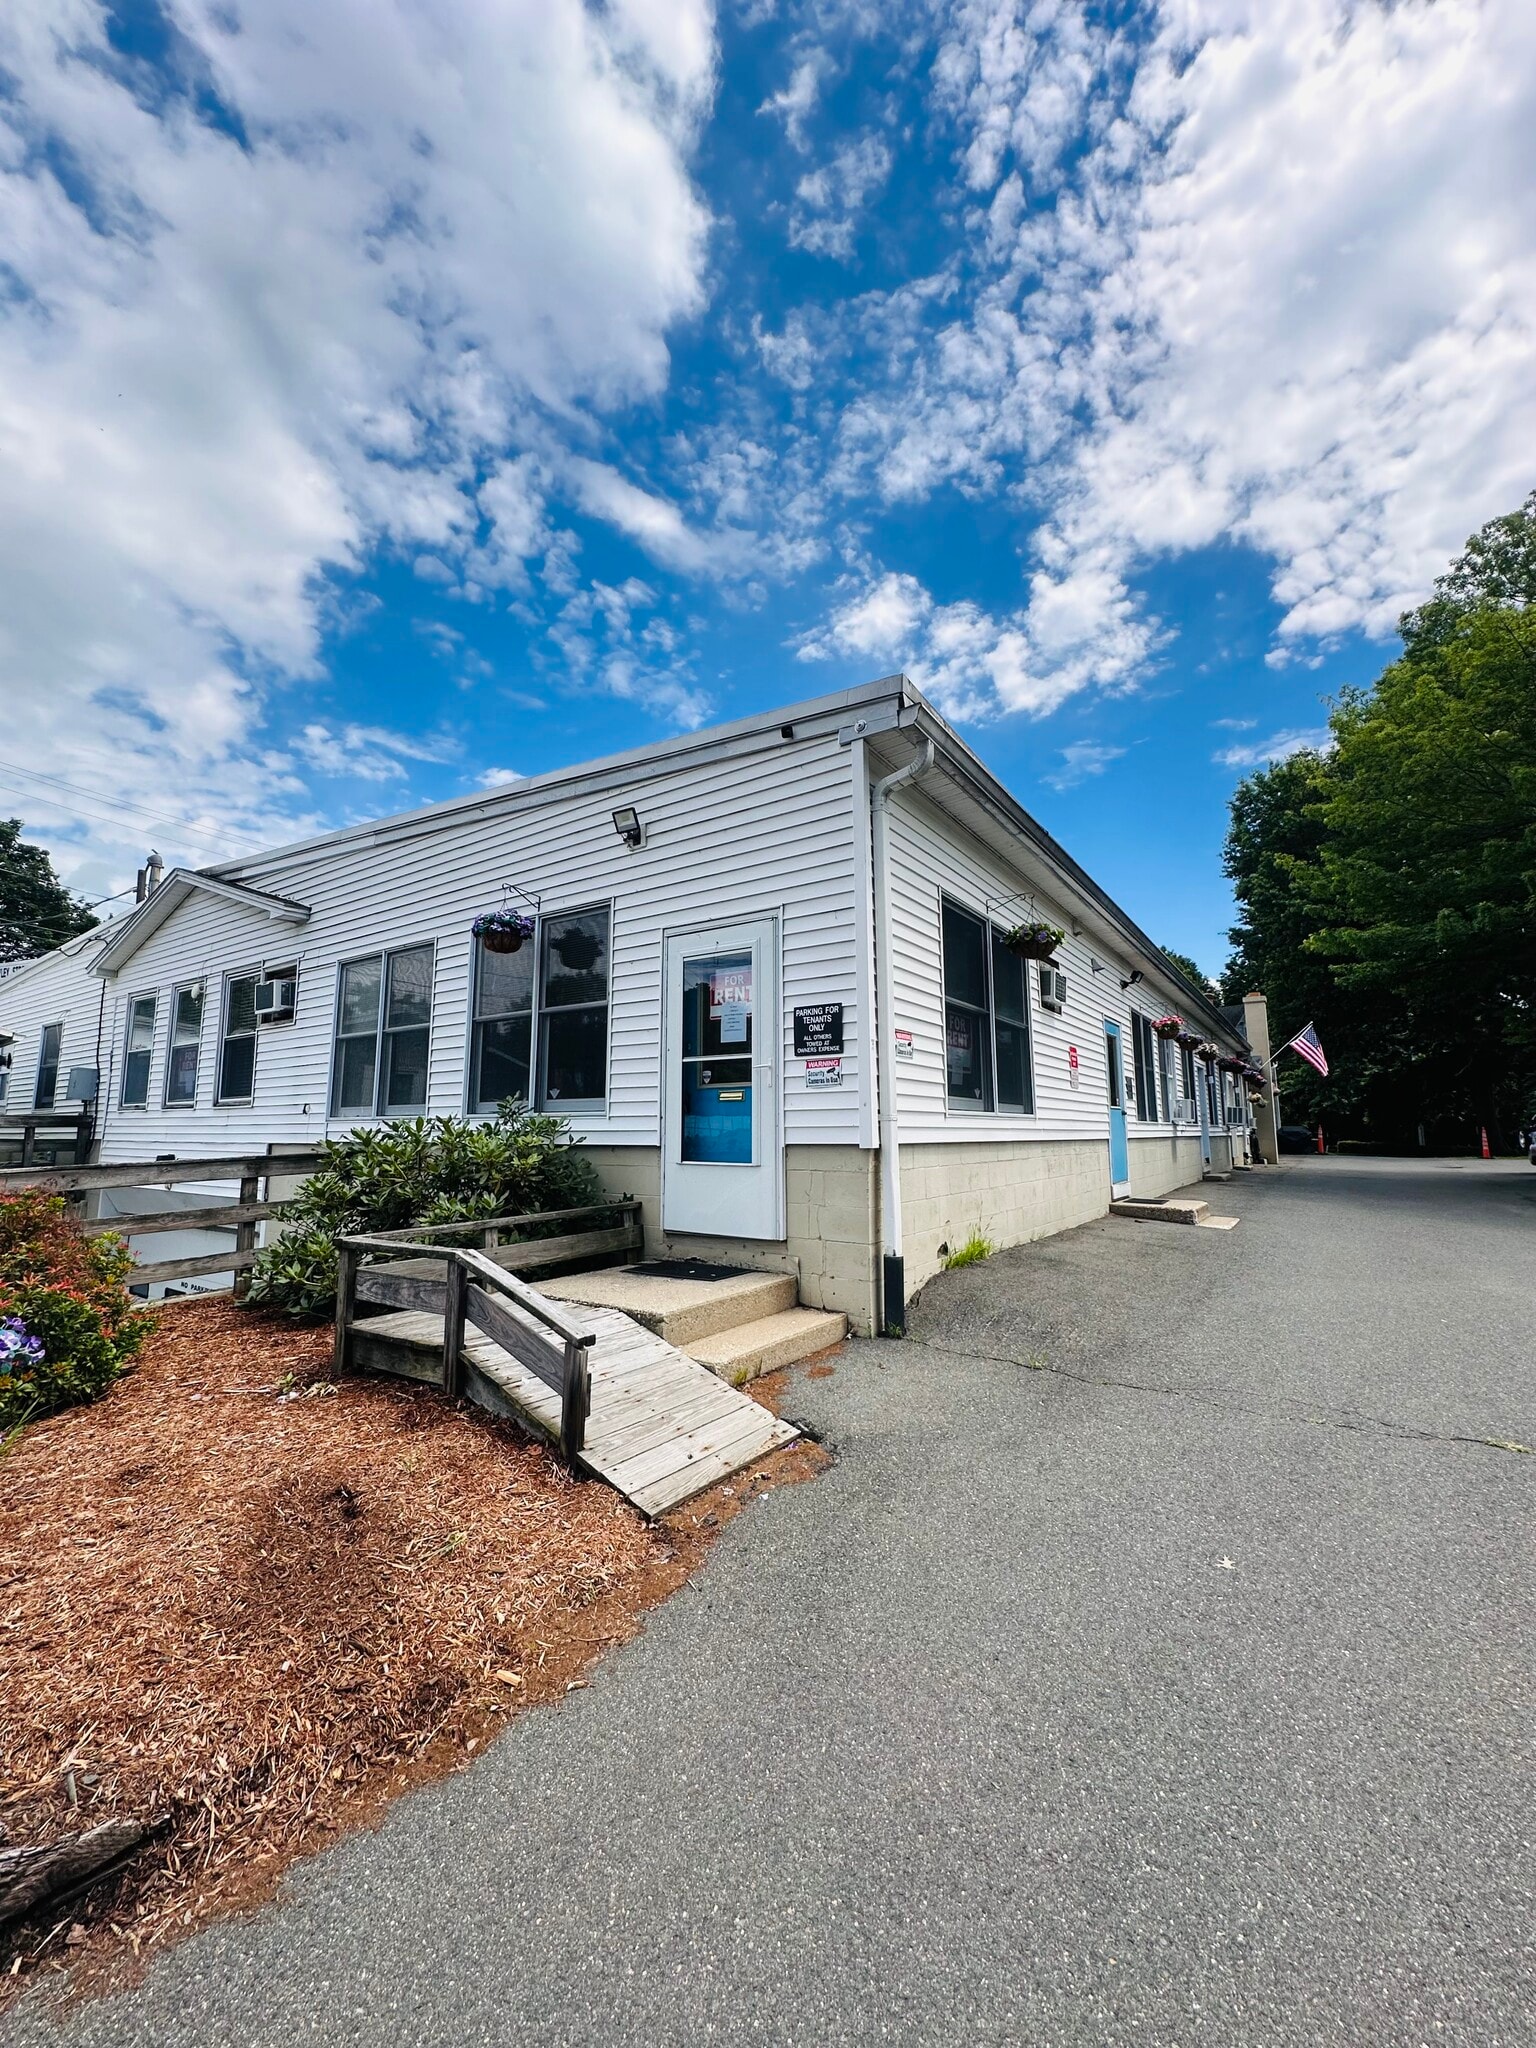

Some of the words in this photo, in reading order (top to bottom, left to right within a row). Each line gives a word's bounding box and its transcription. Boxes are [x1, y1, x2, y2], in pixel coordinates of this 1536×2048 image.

[724, 974, 745, 986] FOR
[714, 985, 752, 1005] RENT
[795, 1007, 823, 1017] PARKING
[825, 1005, 839, 1014] FOR
[803, 1015, 832, 1024] TENANTS
[808, 1023, 825, 1032] ONLY
[797, 1046, 817, 1054] OWNERS
[818, 1045, 840, 1053] EXPENSE
[808, 1060, 839, 1068] WARNING
[807, 1070, 825, 1078] Security
